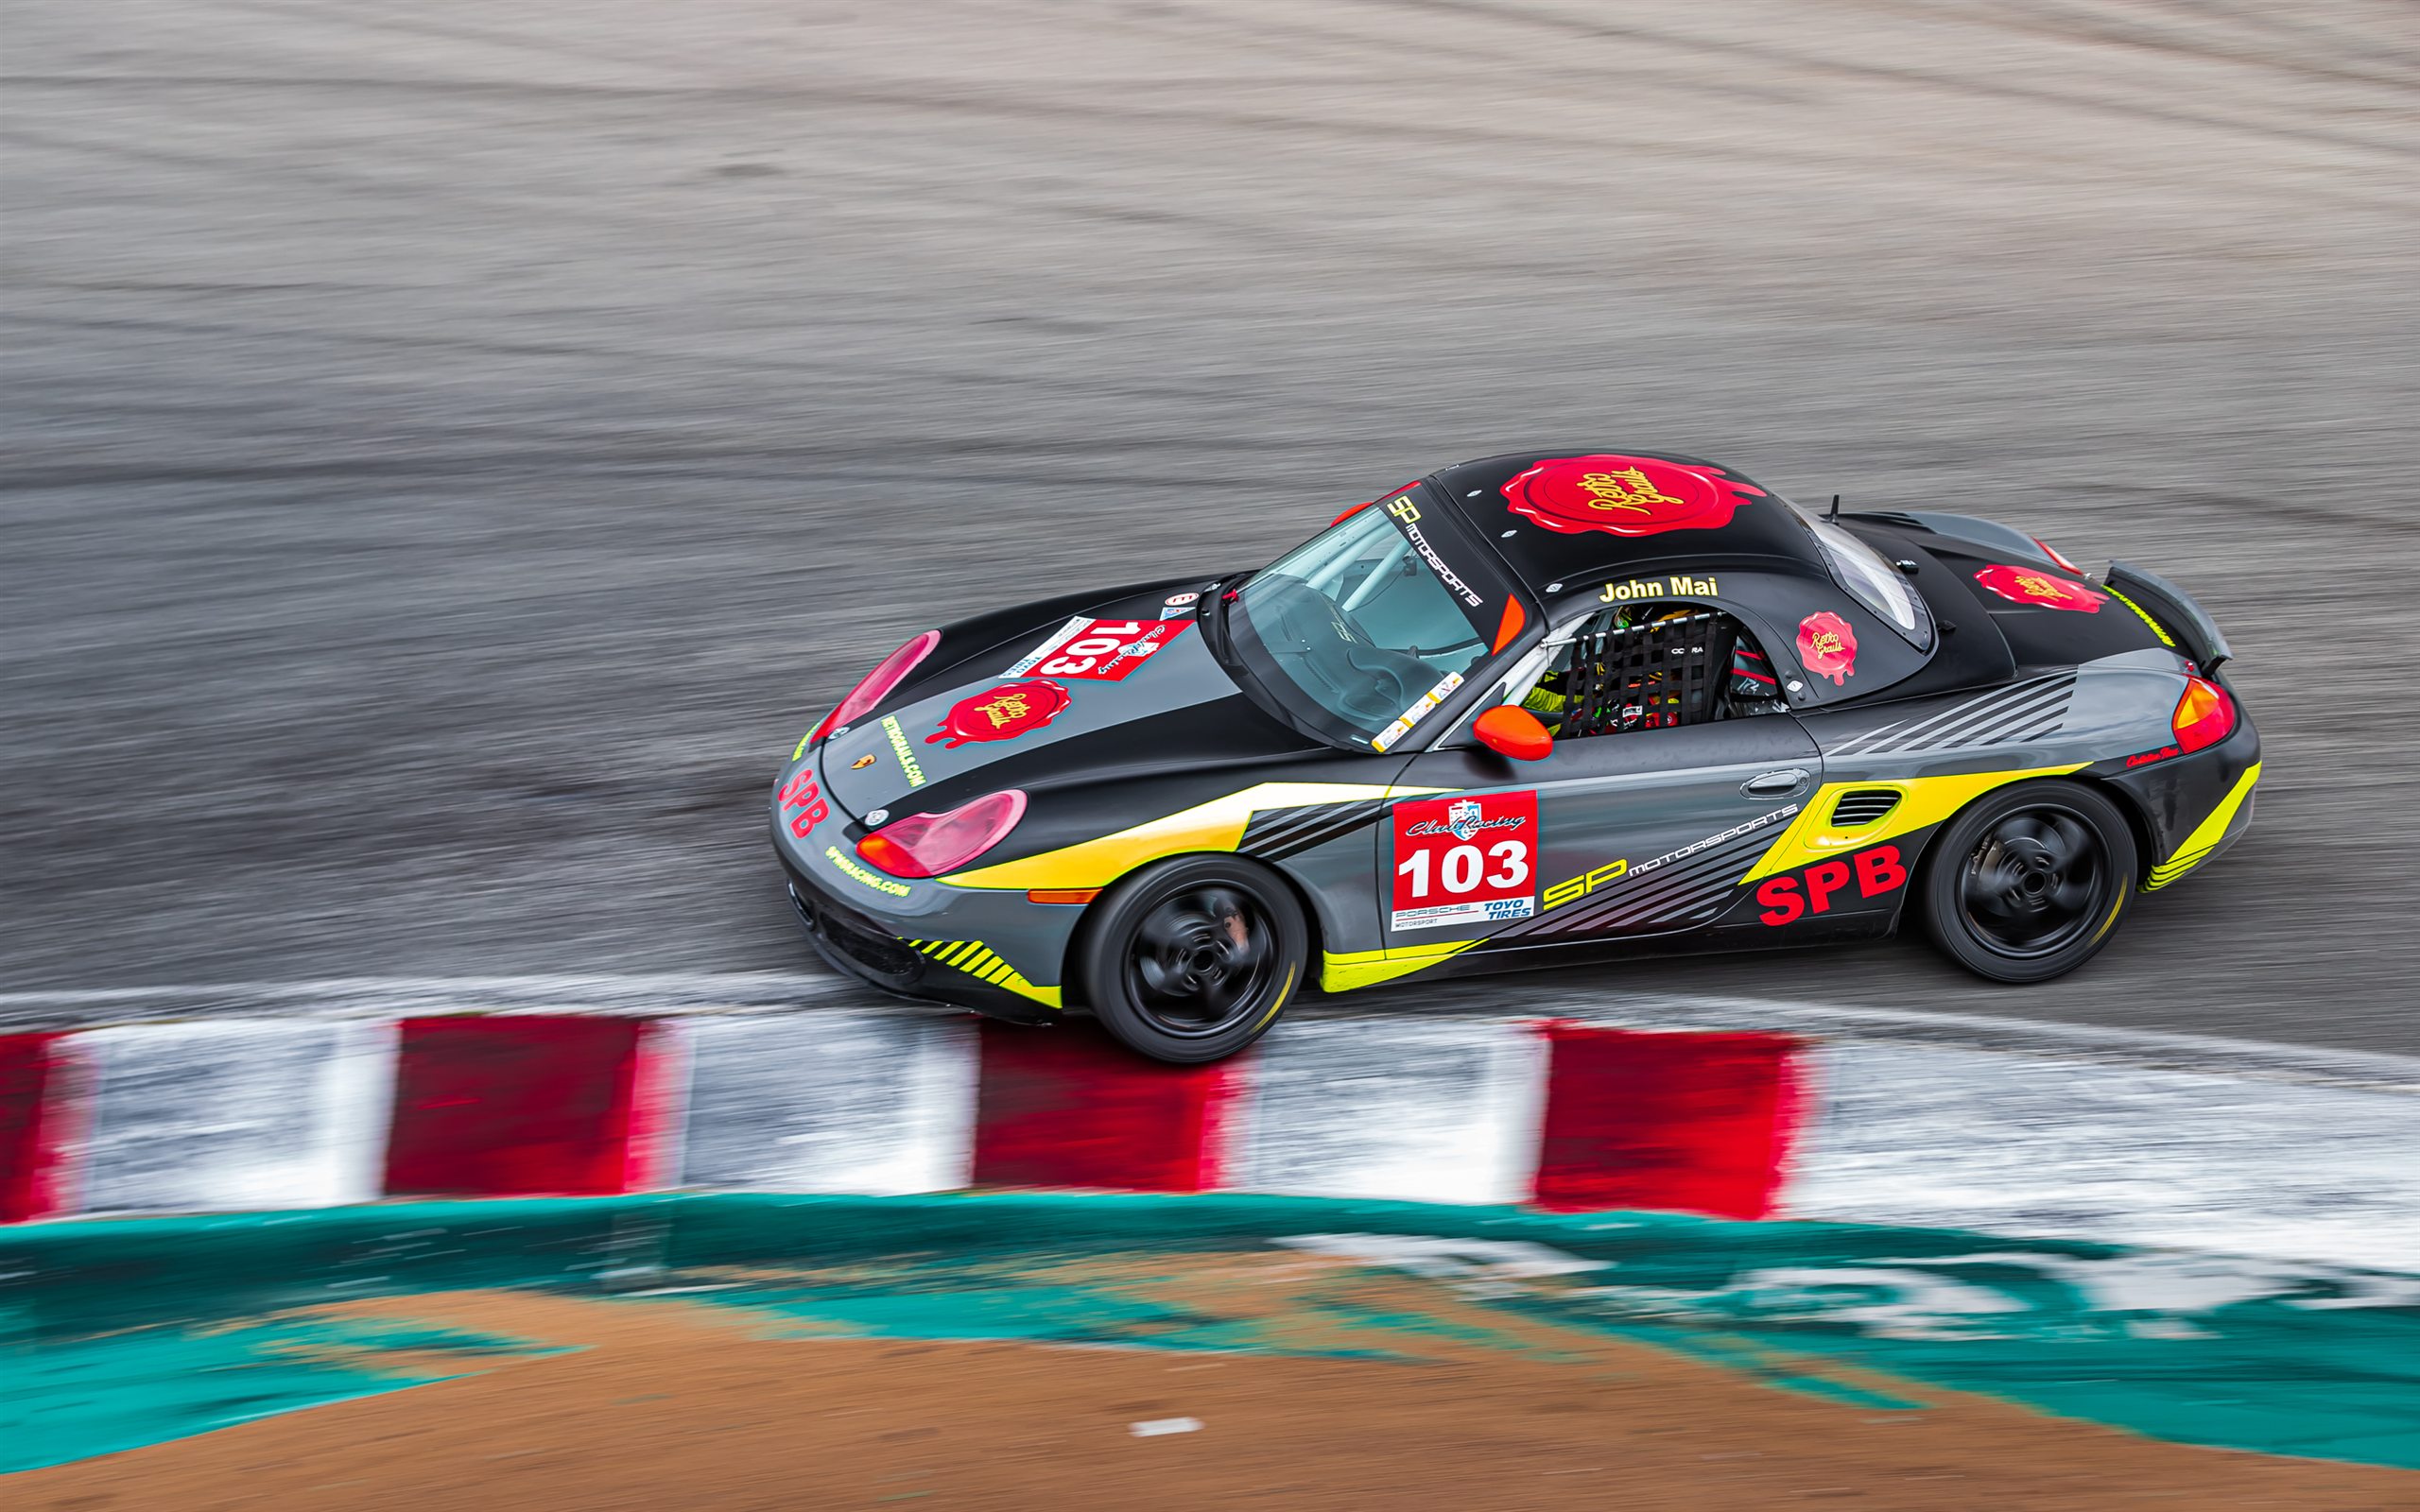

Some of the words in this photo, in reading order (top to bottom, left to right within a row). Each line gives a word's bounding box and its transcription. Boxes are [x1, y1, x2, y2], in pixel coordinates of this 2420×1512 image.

[1386, 495, 1422, 524] SP
[1405, 523, 1484, 607] MOTORSPORTS
[1599, 579, 1665, 603] John
[1669, 576, 1719, 596] Mai
[1039, 621, 1142, 676] 103
[778, 768, 830, 839] SPB
[1398, 840, 1529, 898] 103
[1543, 858, 1628, 911] SP
[1628, 802, 1799, 877] MOTORSPORTS
[1394, 904, 1471, 919] PORSCHE
[1484, 899, 1525, 911] TOYO
[1488, 907, 1531, 919] TIRES
[1755, 845, 1908, 927] SPB
[1395, 919, 1438, 928] MOTORSPORT
